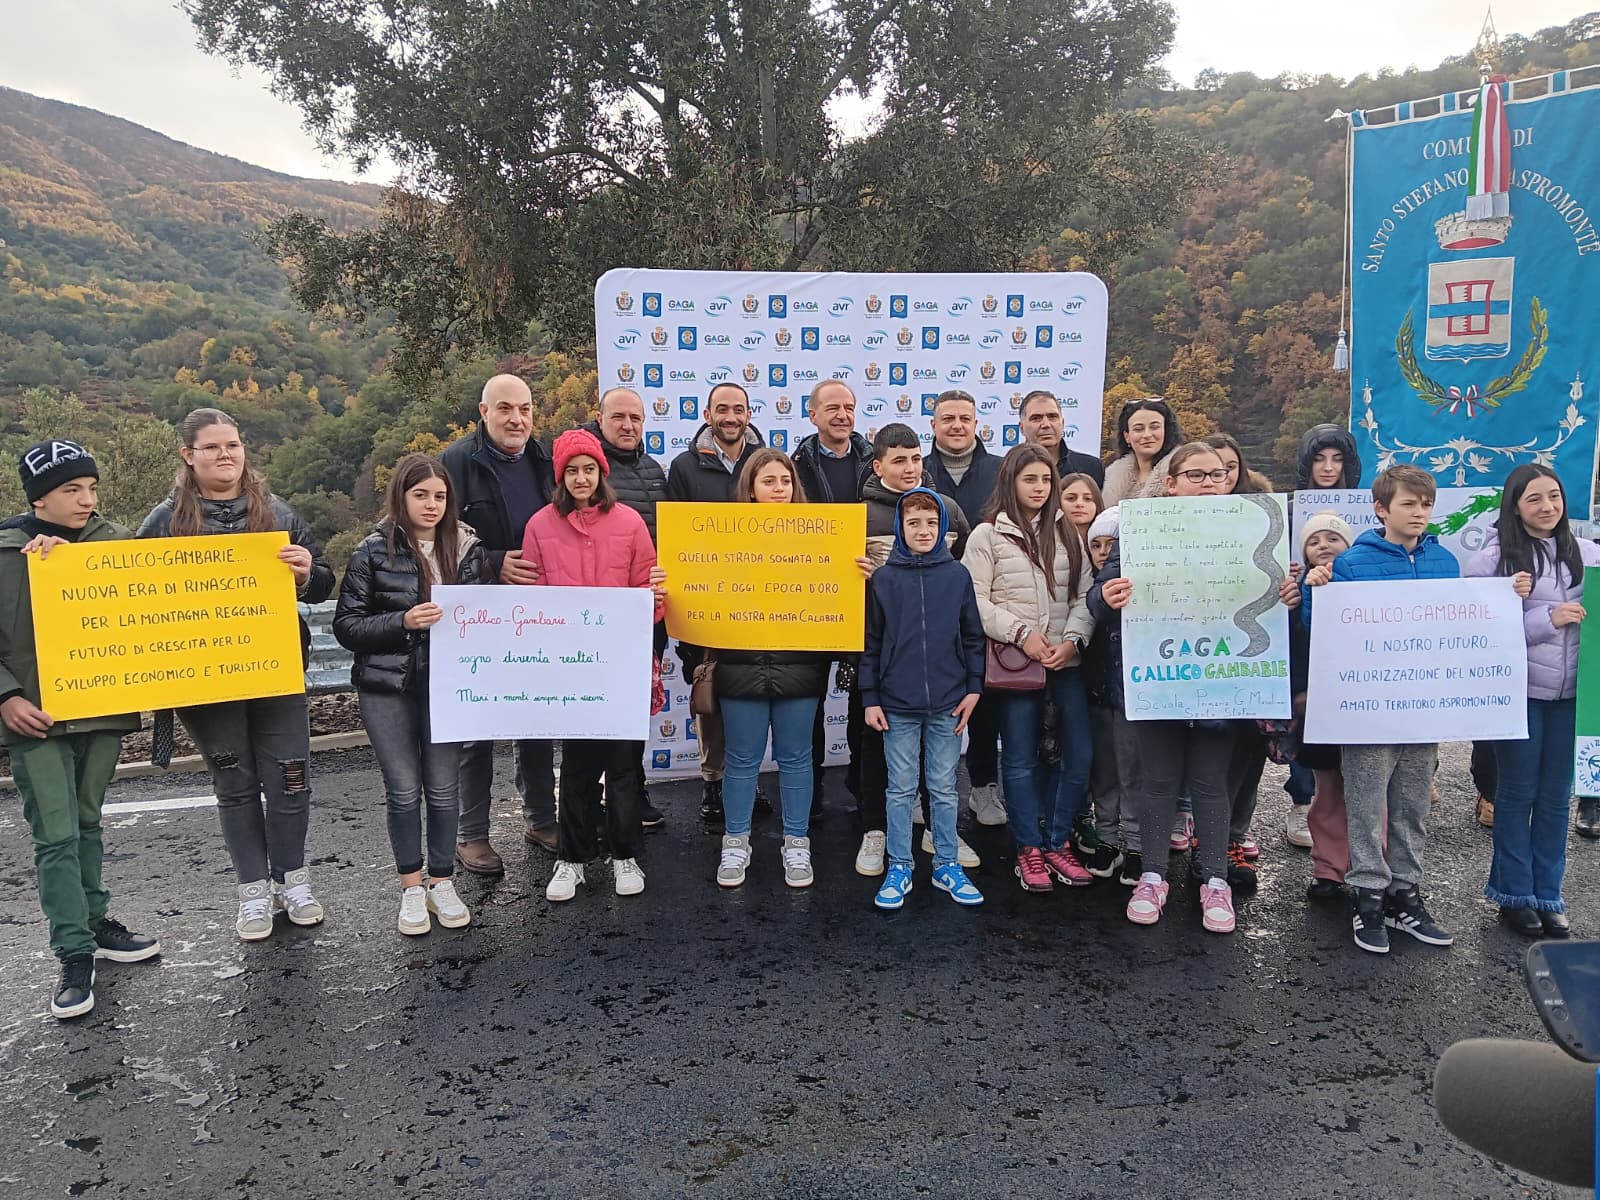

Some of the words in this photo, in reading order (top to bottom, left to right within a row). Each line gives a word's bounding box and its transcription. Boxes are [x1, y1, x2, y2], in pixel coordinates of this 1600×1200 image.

[1513, 127, 1533, 147] DI
[1361, 218, 1396, 273] SANTO
[1392, 168, 1469, 220] STEFANO
[709, 301, 728, 311] avr
[832, 301, 850, 311] avr
[951, 301, 969, 311] avr
[1065, 300, 1082, 310] avr
[618, 334, 637, 344] avr
[743, 335, 762, 345] avr
[866, 335, 884, 345] avr
[982, 334, 1000, 344] avr
[710, 371, 729, 382] avr
[832, 369, 850, 380] avr
[950, 368, 968, 379] avr
[1062, 366, 1080, 376] avr
[751, 405, 762, 413] vr
[866, 401, 884, 412] avr
[980, 400, 997, 410] avr
[1298, 493, 1341, 505] SCUOLA
[1121, 520, 1148, 536] Cara
[678, 551, 719, 564] QUELLA
[724, 551, 764, 563] STRADA
[769, 553, 812, 565] SOGNATA
[818, 555, 831, 565] DA
[61, 584, 119, 602] NUOVA
[128, 583, 157, 598] ERA
[165, 583, 177, 594] DI
[184, 576, 258, 593] RINASCITA
[683, 583, 709, 593] ANNI
[717, 579, 726, 593] È
[731, 583, 755, 594] OGGI
[764, 583, 803, 594] EPOCA
[81, 616, 110, 630] PER
[119, 613, 137, 627] LA
[141, 610, 209, 625] MONTAGNA
[687, 610, 705, 621] PER
[710, 611, 721, 621] LA
[729, 610, 765, 622] NOSTRA
[769, 612, 798, 622] AMATA
[69, 644, 127, 661] FUTURO
[133, 644, 144, 655] DI
[149, 638, 207, 653] CRESCITA
[212, 636, 234, 648] PER
[237, 634, 252, 646] LO
[1364, 639, 1376, 653] IL
[1383, 638, 1433, 653] NOSTRO
[458, 655, 493, 674] sogno
[502, 648, 551, 664] diventa
[1204, 658, 1289, 680] GAMBARIE
[1338, 668, 1441, 683] VALORIZZAZIONE
[1446, 667, 1464, 680] DEL
[1469, 665, 1512, 678] NOSTRO
[54, 675, 118, 693] SVILUPPO
[124, 667, 196, 686] ECONOMICO
[203, 665, 212, 678] E
[218, 658, 280, 676] TURISTICO
[456, 688, 489, 703] Mari
[503, 691, 530, 702] monti
[1135, 690, 1184, 713] Scuola
[1339, 699, 1380, 712] AMATO
[1386, 698, 1436, 711] TERRITORIO
[1439, 695, 1512, 709] ASPROMONTANO
